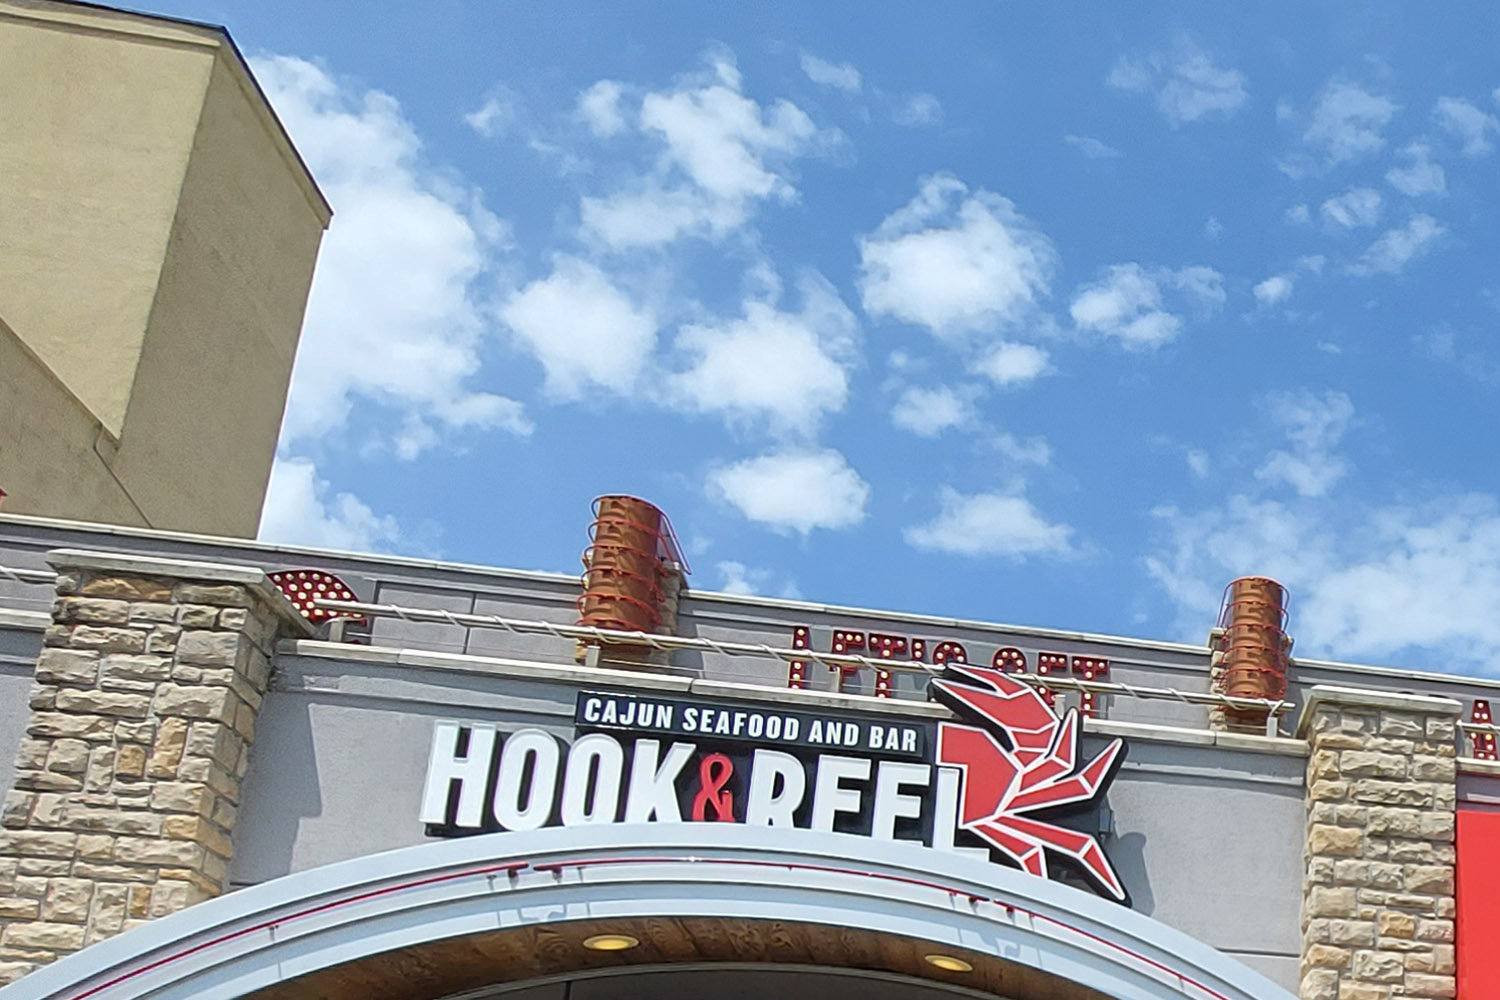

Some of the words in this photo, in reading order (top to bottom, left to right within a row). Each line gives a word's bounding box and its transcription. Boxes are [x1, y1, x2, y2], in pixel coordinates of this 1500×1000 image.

[582, 697, 674, 729] CAJUN
[682, 706, 800, 740] SEAFOOD
[808, 721, 859, 747] AND
[868, 724, 918, 753] BAR
